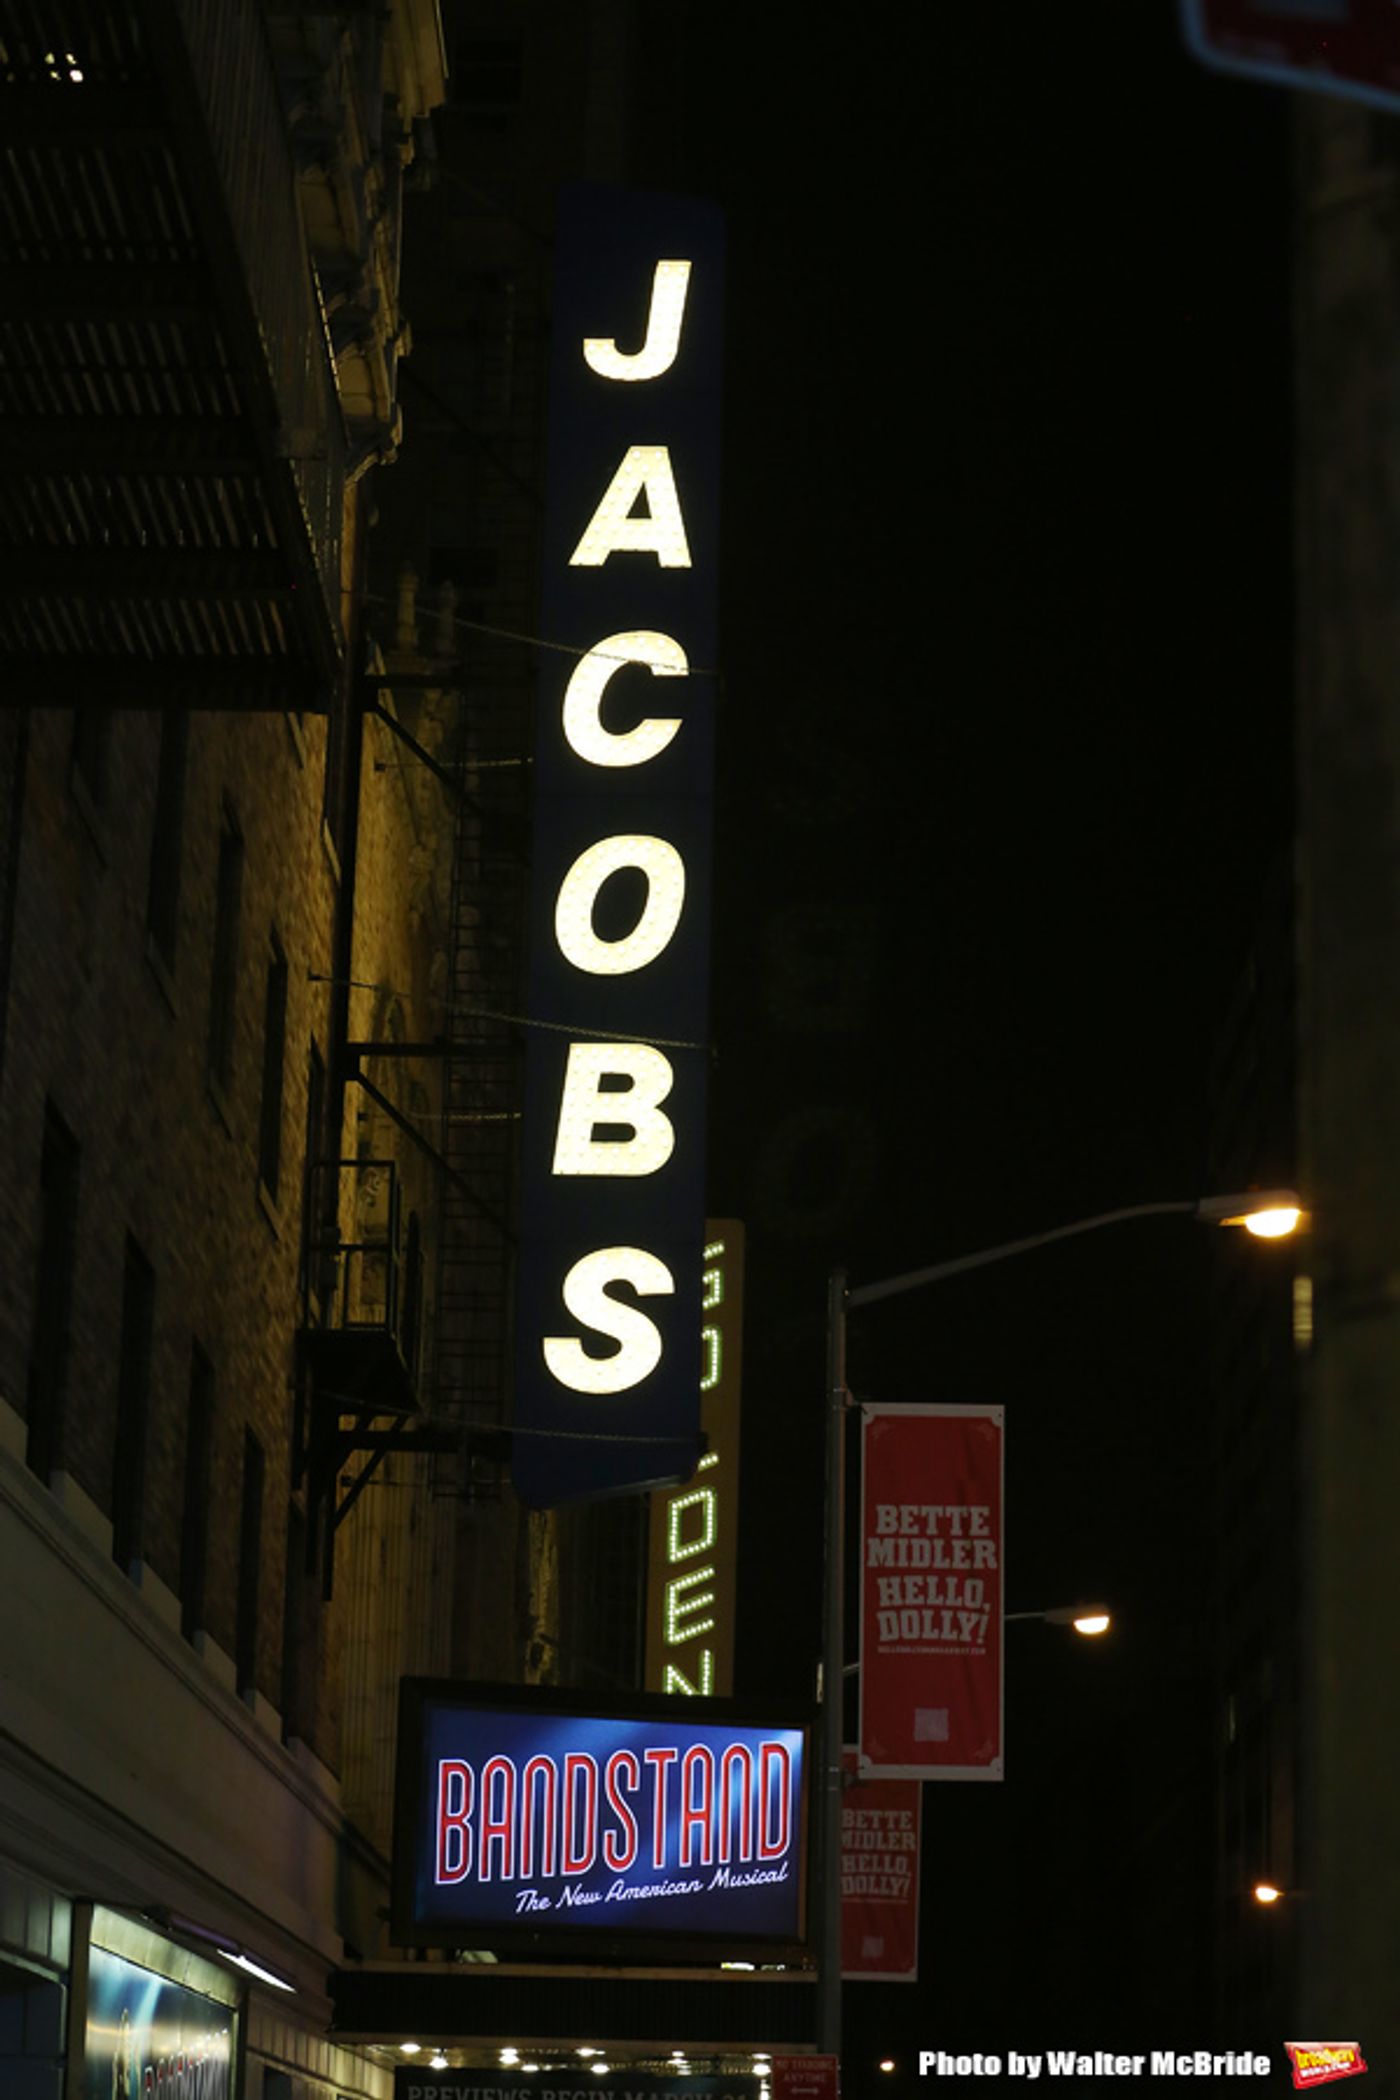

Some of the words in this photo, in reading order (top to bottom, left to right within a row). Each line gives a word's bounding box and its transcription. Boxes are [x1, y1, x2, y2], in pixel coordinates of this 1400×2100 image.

[544, 261, 691, 1393] JACOBS
[876, 1505, 990, 1536] BETTE
[867, 1537, 998, 1569] MIDLER
[877, 1576, 991, 1612] HELLO,
[876, 1609, 989, 1644] DOLLY!
[435, 1741, 791, 1885] BANDSTAND
[841, 1808, 912, 1830] BETTE
[515, 1890, 551, 1913] The
[556, 1884, 601, 1908] New
[605, 1879, 703, 1902] American
[708, 1861, 788, 1890] Musical
